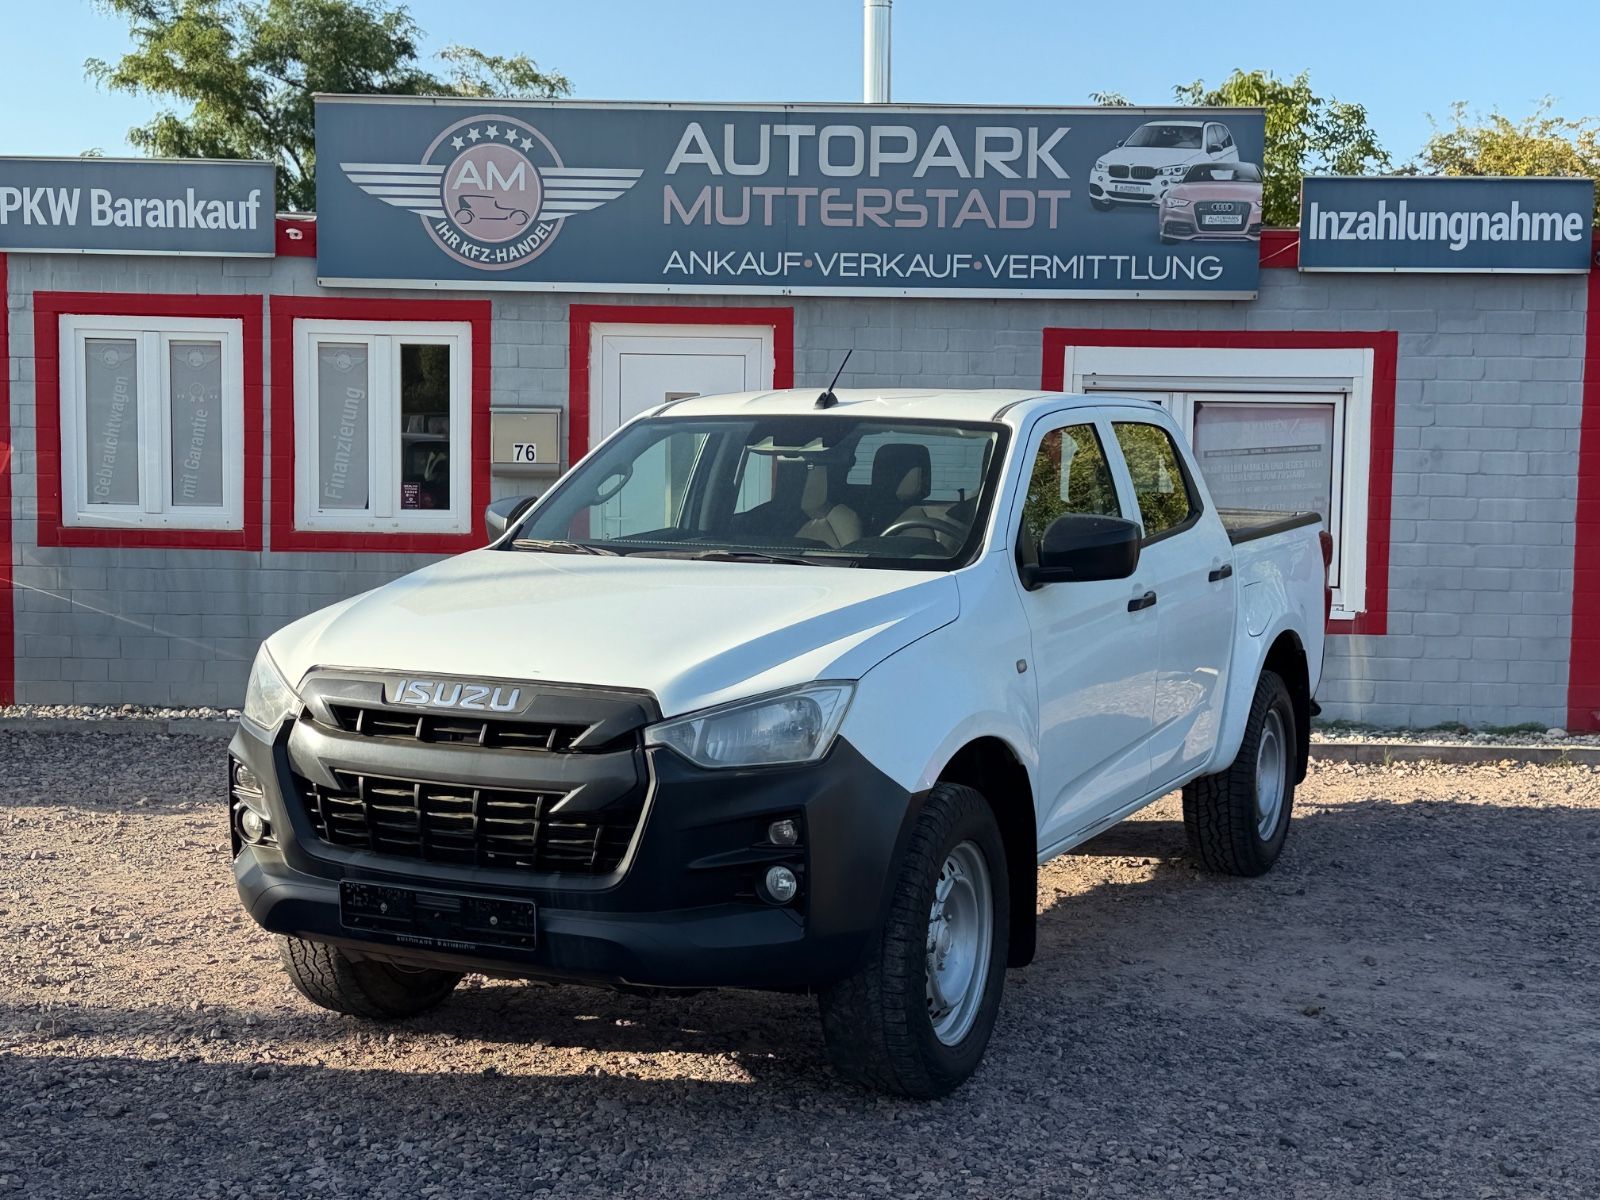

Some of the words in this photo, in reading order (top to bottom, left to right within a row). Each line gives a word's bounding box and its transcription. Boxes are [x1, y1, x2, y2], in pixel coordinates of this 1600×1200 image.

[664, 122, 1071, 181] AUTOPARK
[452, 160, 526, 192] AM
[0, 187, 80, 226] PKW
[91, 187, 261, 230] Barankauf
[663, 184, 1071, 230] MUTTERSTADT
[1308, 200, 1583, 252] Inzahlungnahme
[435, 220, 461, 249] IHR
[460, 221, 555, 263] KFZ-HANDEL
[663, 250, 803, 275] ANKAUF
[818, 252, 972, 277] VERKAUF
[984, 254, 1224, 281] VERMITTLUNG
[94, 375, 129, 497] Gebrauchtwagen
[184, 408, 209, 470] Garantie
[324, 386, 366, 500] Finanzierung
[514, 444, 535, 461] 76
[182, 474, 198, 498] mit
[394, 680, 521, 712] ISUZU
